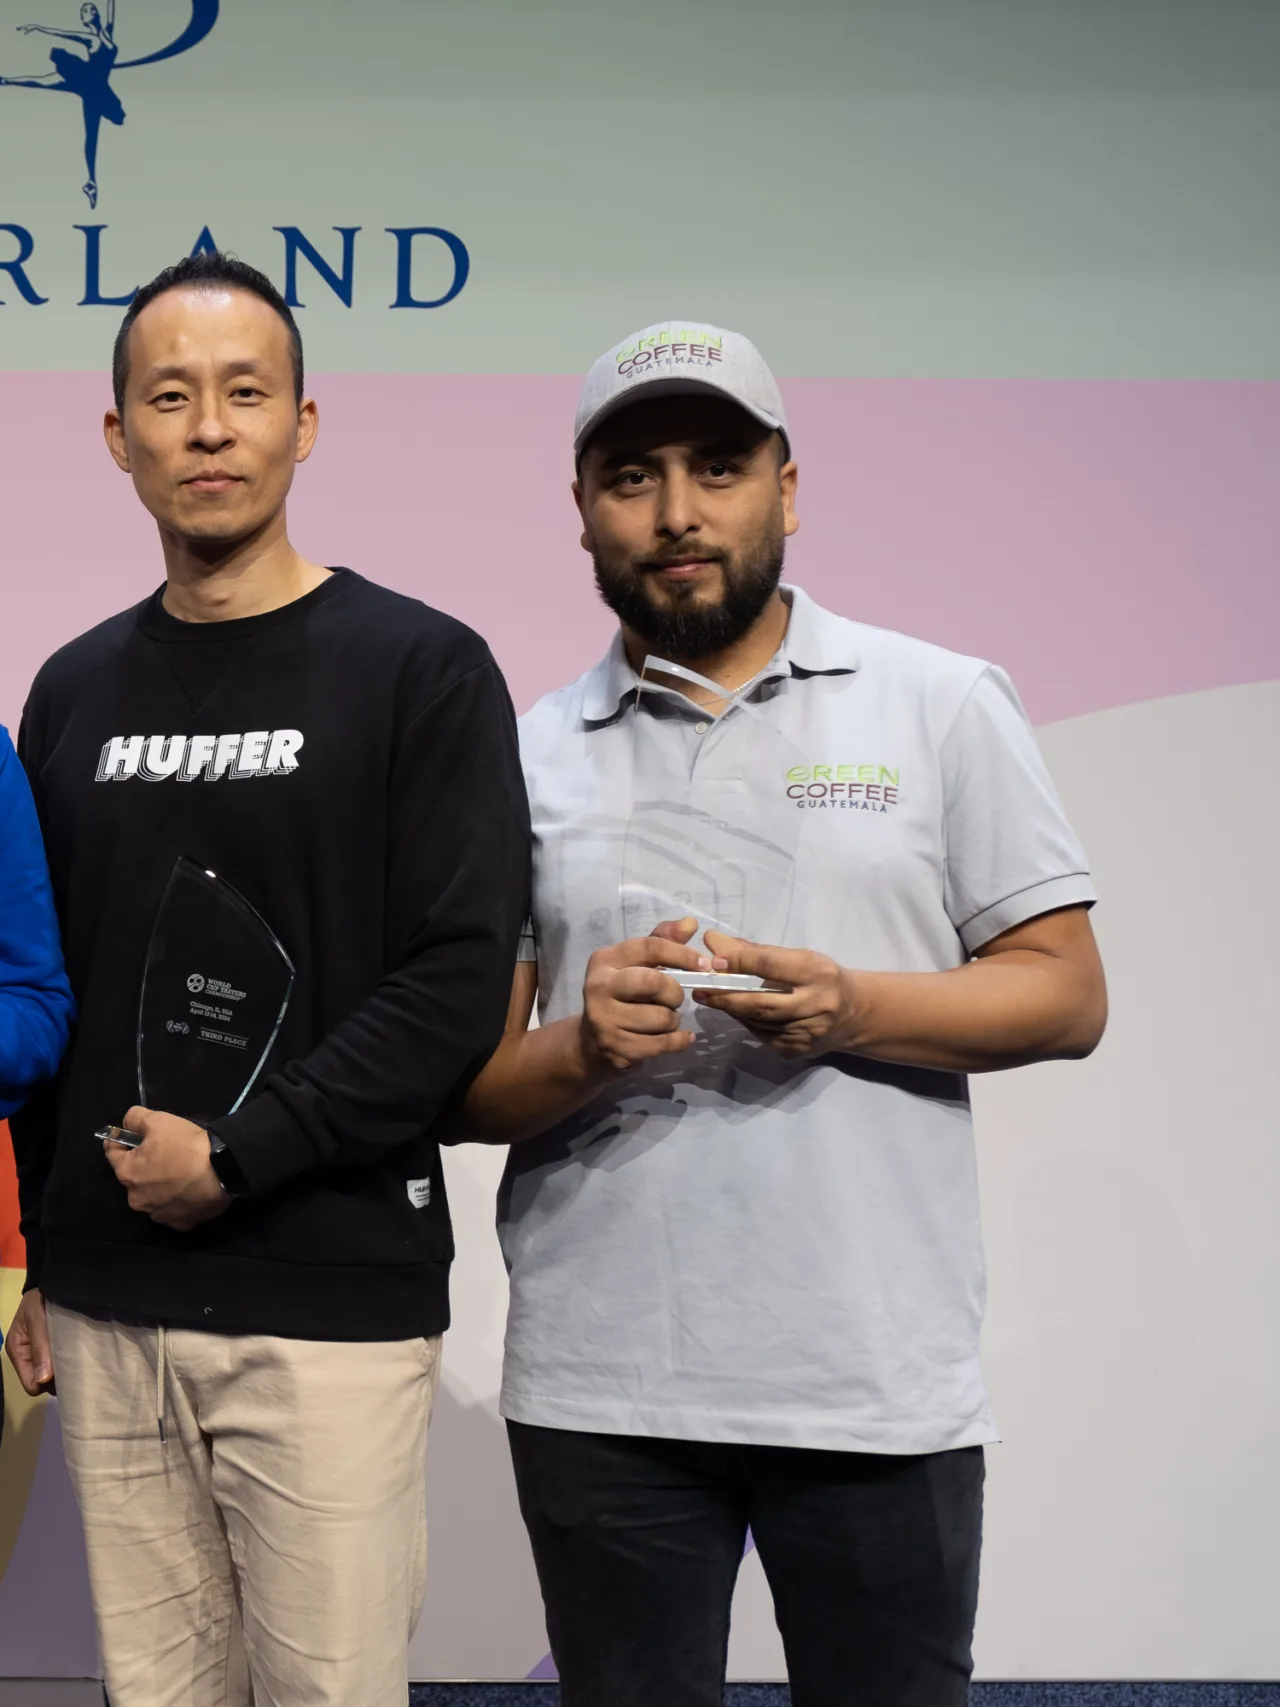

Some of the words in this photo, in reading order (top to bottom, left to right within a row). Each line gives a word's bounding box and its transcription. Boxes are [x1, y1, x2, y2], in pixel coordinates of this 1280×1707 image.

[616, 330, 723, 362] GREEN
[618, 343, 722, 374] COFFEE
[627, 357, 712, 379] GUATEMALA
[95, 729, 304, 782] HUFFER
[786, 765, 899, 785] GREEN
[786, 783, 898, 805] COFFEE
[797, 800, 888, 813] GUATEMALA
[207, 978, 231, 989] WORLD
[220, 986, 247, 998] TASTERS
[190, 1007, 203, 1016] April
[218, 1013, 231, 1022] 2024
[222, 1008, 233, 1016] USA
[201, 1030, 223, 1041] THIRD
[224, 1036, 247, 1047] PLACE
